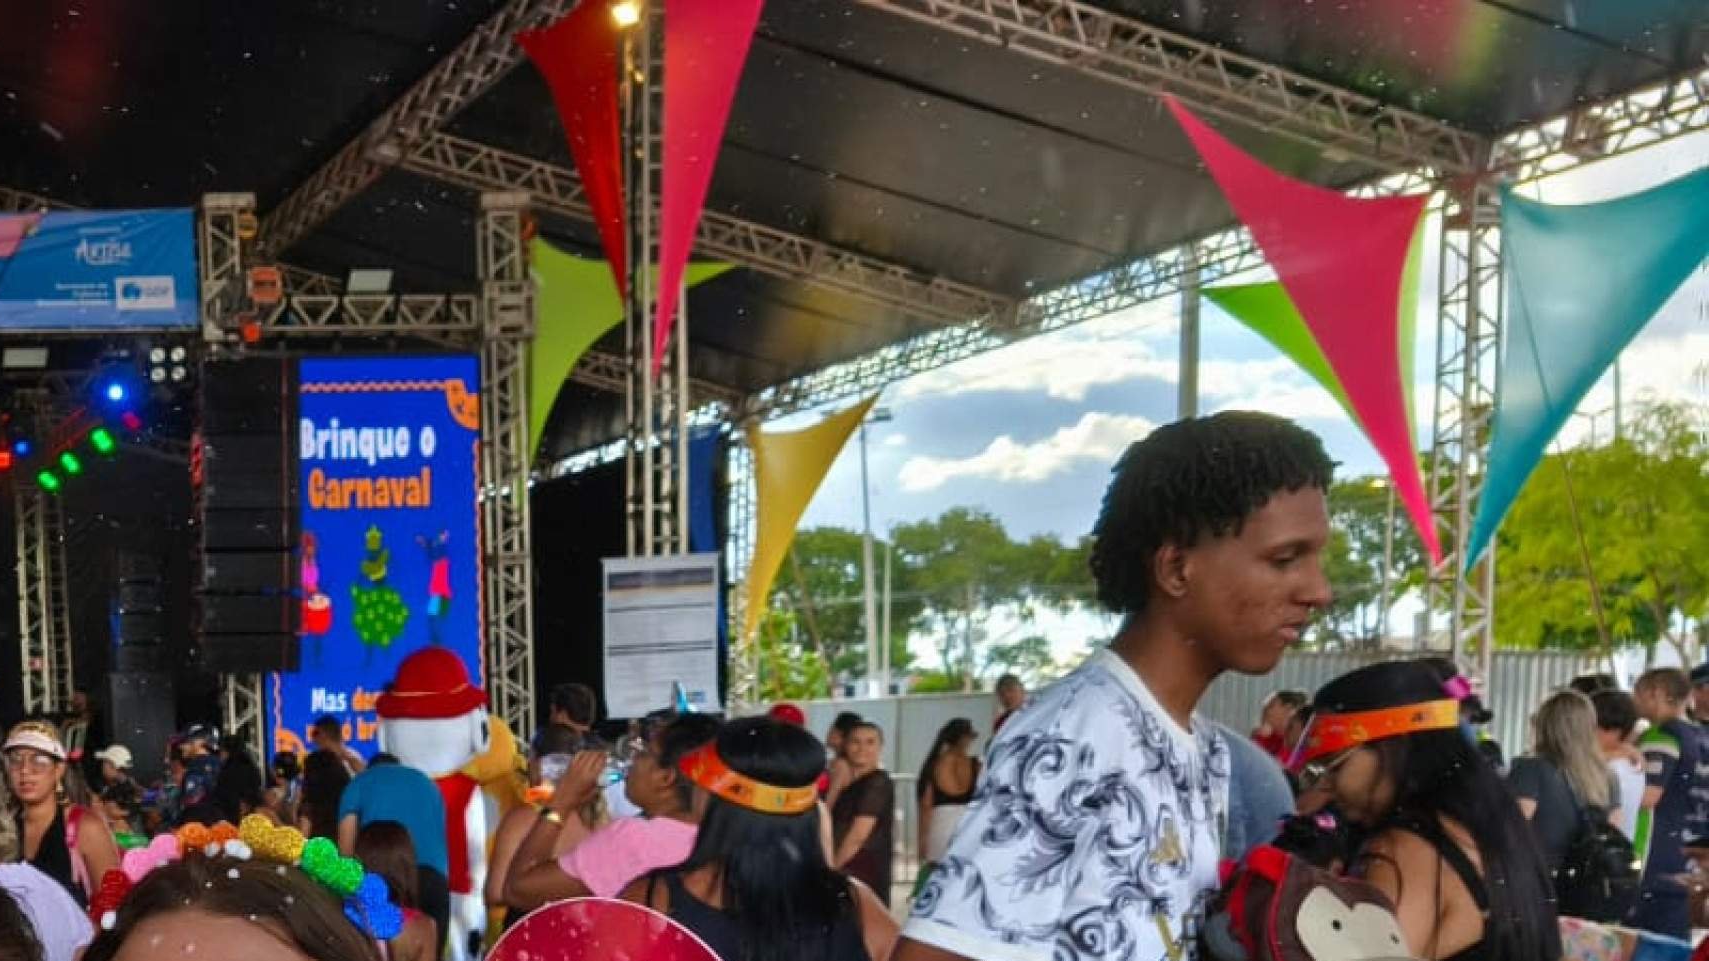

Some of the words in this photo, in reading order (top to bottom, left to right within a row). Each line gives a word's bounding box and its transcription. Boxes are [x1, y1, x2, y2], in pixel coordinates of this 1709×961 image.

[299, 417, 411, 466] Brinque
[419, 425, 437, 458] o
[307, 466, 432, 509] Carnaval
[310, 687, 348, 713] Mas
